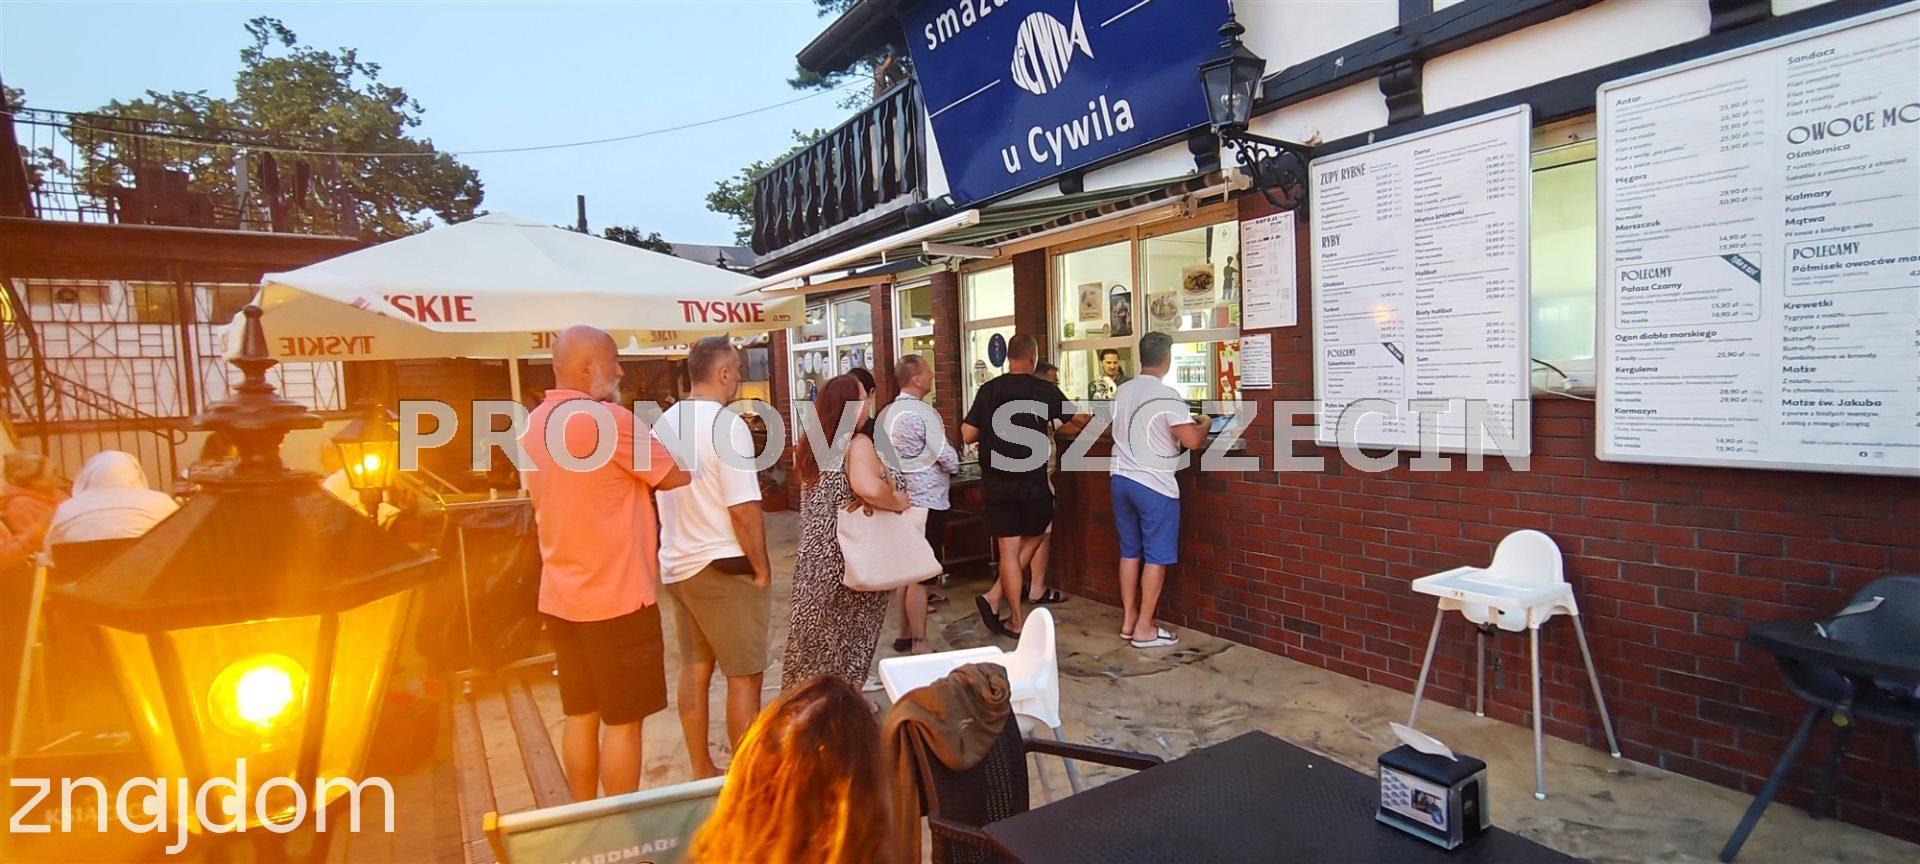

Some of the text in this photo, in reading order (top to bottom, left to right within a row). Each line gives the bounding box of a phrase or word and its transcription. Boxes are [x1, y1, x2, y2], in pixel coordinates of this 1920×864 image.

[1788, 48, 1836, 65] Sandacz
[1002, 95, 1135, 173] u Cywila
[1787, 112, 1875, 144] OWOCE
[1786, 144, 1851, 160] Ośmiornica
[1320, 170, 1339, 185] ZUPY
[1341, 163, 1366, 180] RYBNE
[1785, 190, 1832, 202] Kalmary
[1615, 219, 1661, 231] Morszczuk
[1785, 216, 1825, 227] Mątwa
[1321, 233, 1340, 248] RYBY
[1793, 241, 1861, 260] POLECAMY
[1792, 255, 1920, 273] Półmisek owoców mo
[1621, 266, 1673, 281] POLECAMY
[1651, 283, 1683, 291] Czarny
[378, 294, 476, 322] SKIE
[677, 300, 766, 324] TYSKIE
[1784, 299, 1833, 310] Krewetki
[1615, 329, 1717, 342] Ogon diabła morskiego
[1615, 366, 1659, 374] Kergulena
[1782, 365, 1817, 373] Małże
[1782, 399, 1816, 407] Małże
[1837, 399, 1882, 407] Jakuba
